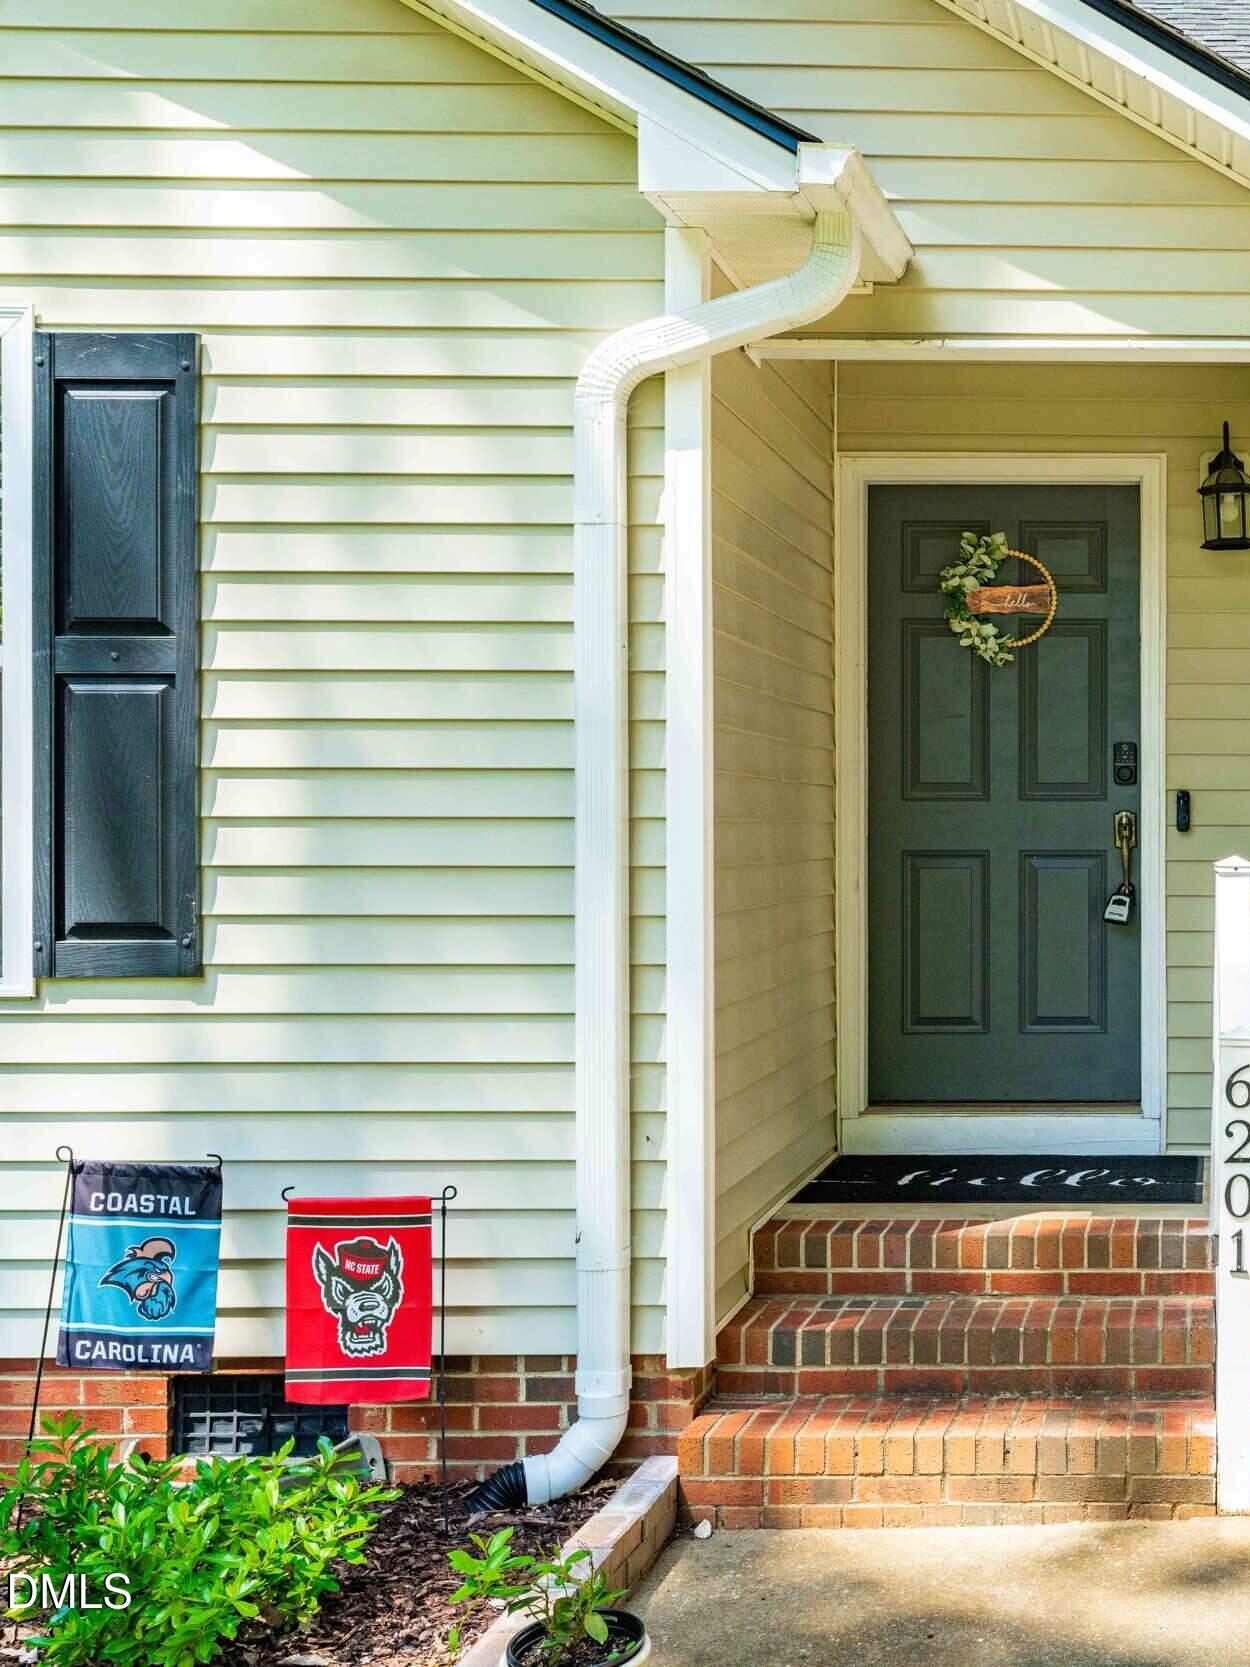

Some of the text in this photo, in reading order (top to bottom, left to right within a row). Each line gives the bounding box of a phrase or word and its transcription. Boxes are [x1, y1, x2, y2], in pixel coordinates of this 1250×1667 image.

[89, 1192, 197, 1216] COASTAL
[344, 1258, 380, 1275] NC STATE
[74, 1339, 196, 1364] CAROLINA
